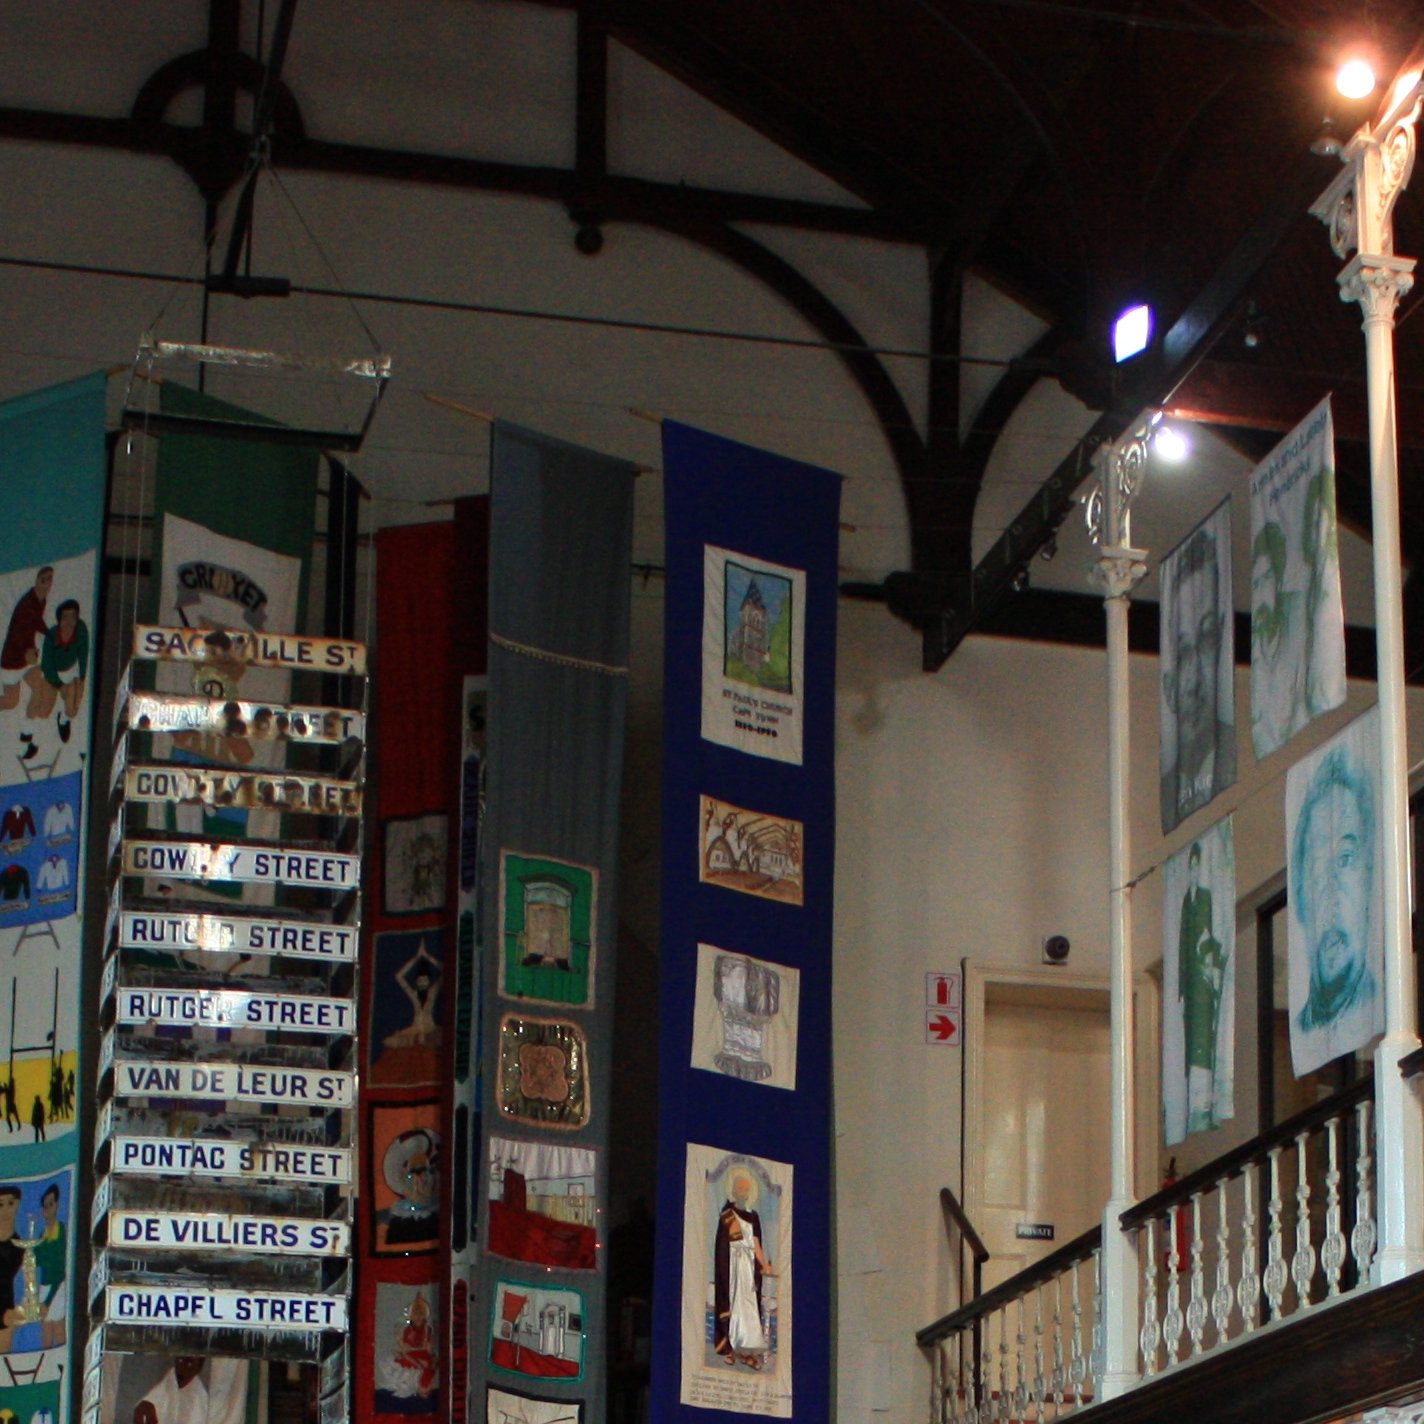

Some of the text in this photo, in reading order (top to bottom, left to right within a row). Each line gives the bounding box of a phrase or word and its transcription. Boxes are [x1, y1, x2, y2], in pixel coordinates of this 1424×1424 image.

[255, 855, 350, 883] STREET
[250, 926, 350, 955] STREET
[130, 995, 348, 1027] RUTGER STREET
[128, 1067, 180, 1092] VAN
[192, 1070, 225, 1093] DE
[237, 1072, 308, 1098] LEUR
[124, 1143, 342, 1177] PONTAC STREET
[124, 1218, 168, 1242] DE
[171, 1220, 299, 1247] VILLIERS
[235, 1297, 335, 1324] STREET
